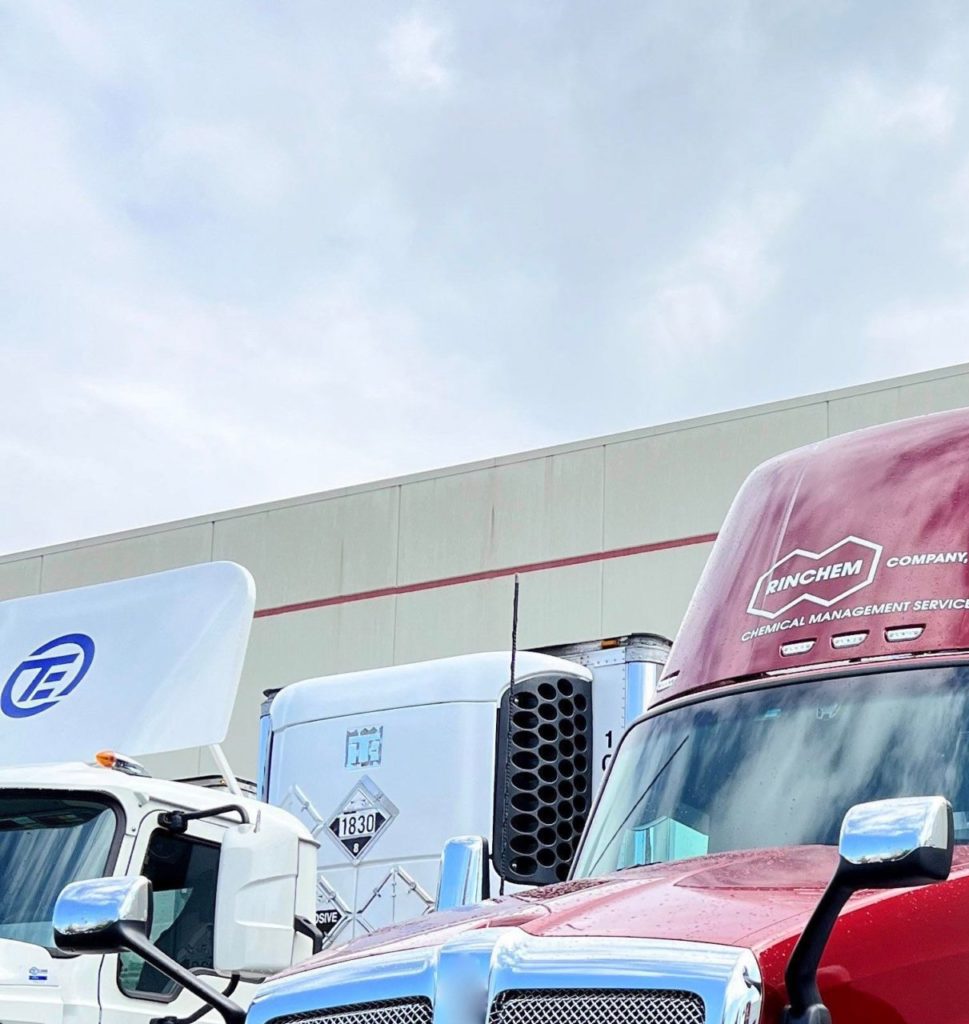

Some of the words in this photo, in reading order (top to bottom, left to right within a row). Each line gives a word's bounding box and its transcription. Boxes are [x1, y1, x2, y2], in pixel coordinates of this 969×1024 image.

[765, 559, 863, 596] RINCHEM
[886, 551, 969, 568] COMPANY,
[741, 616, 806, 642] CHEMICAL
[808, 601, 910, 625] MANAGEMENT
[341, 814, 375, 836] 1830
[353, 842, 360, 854] 8
